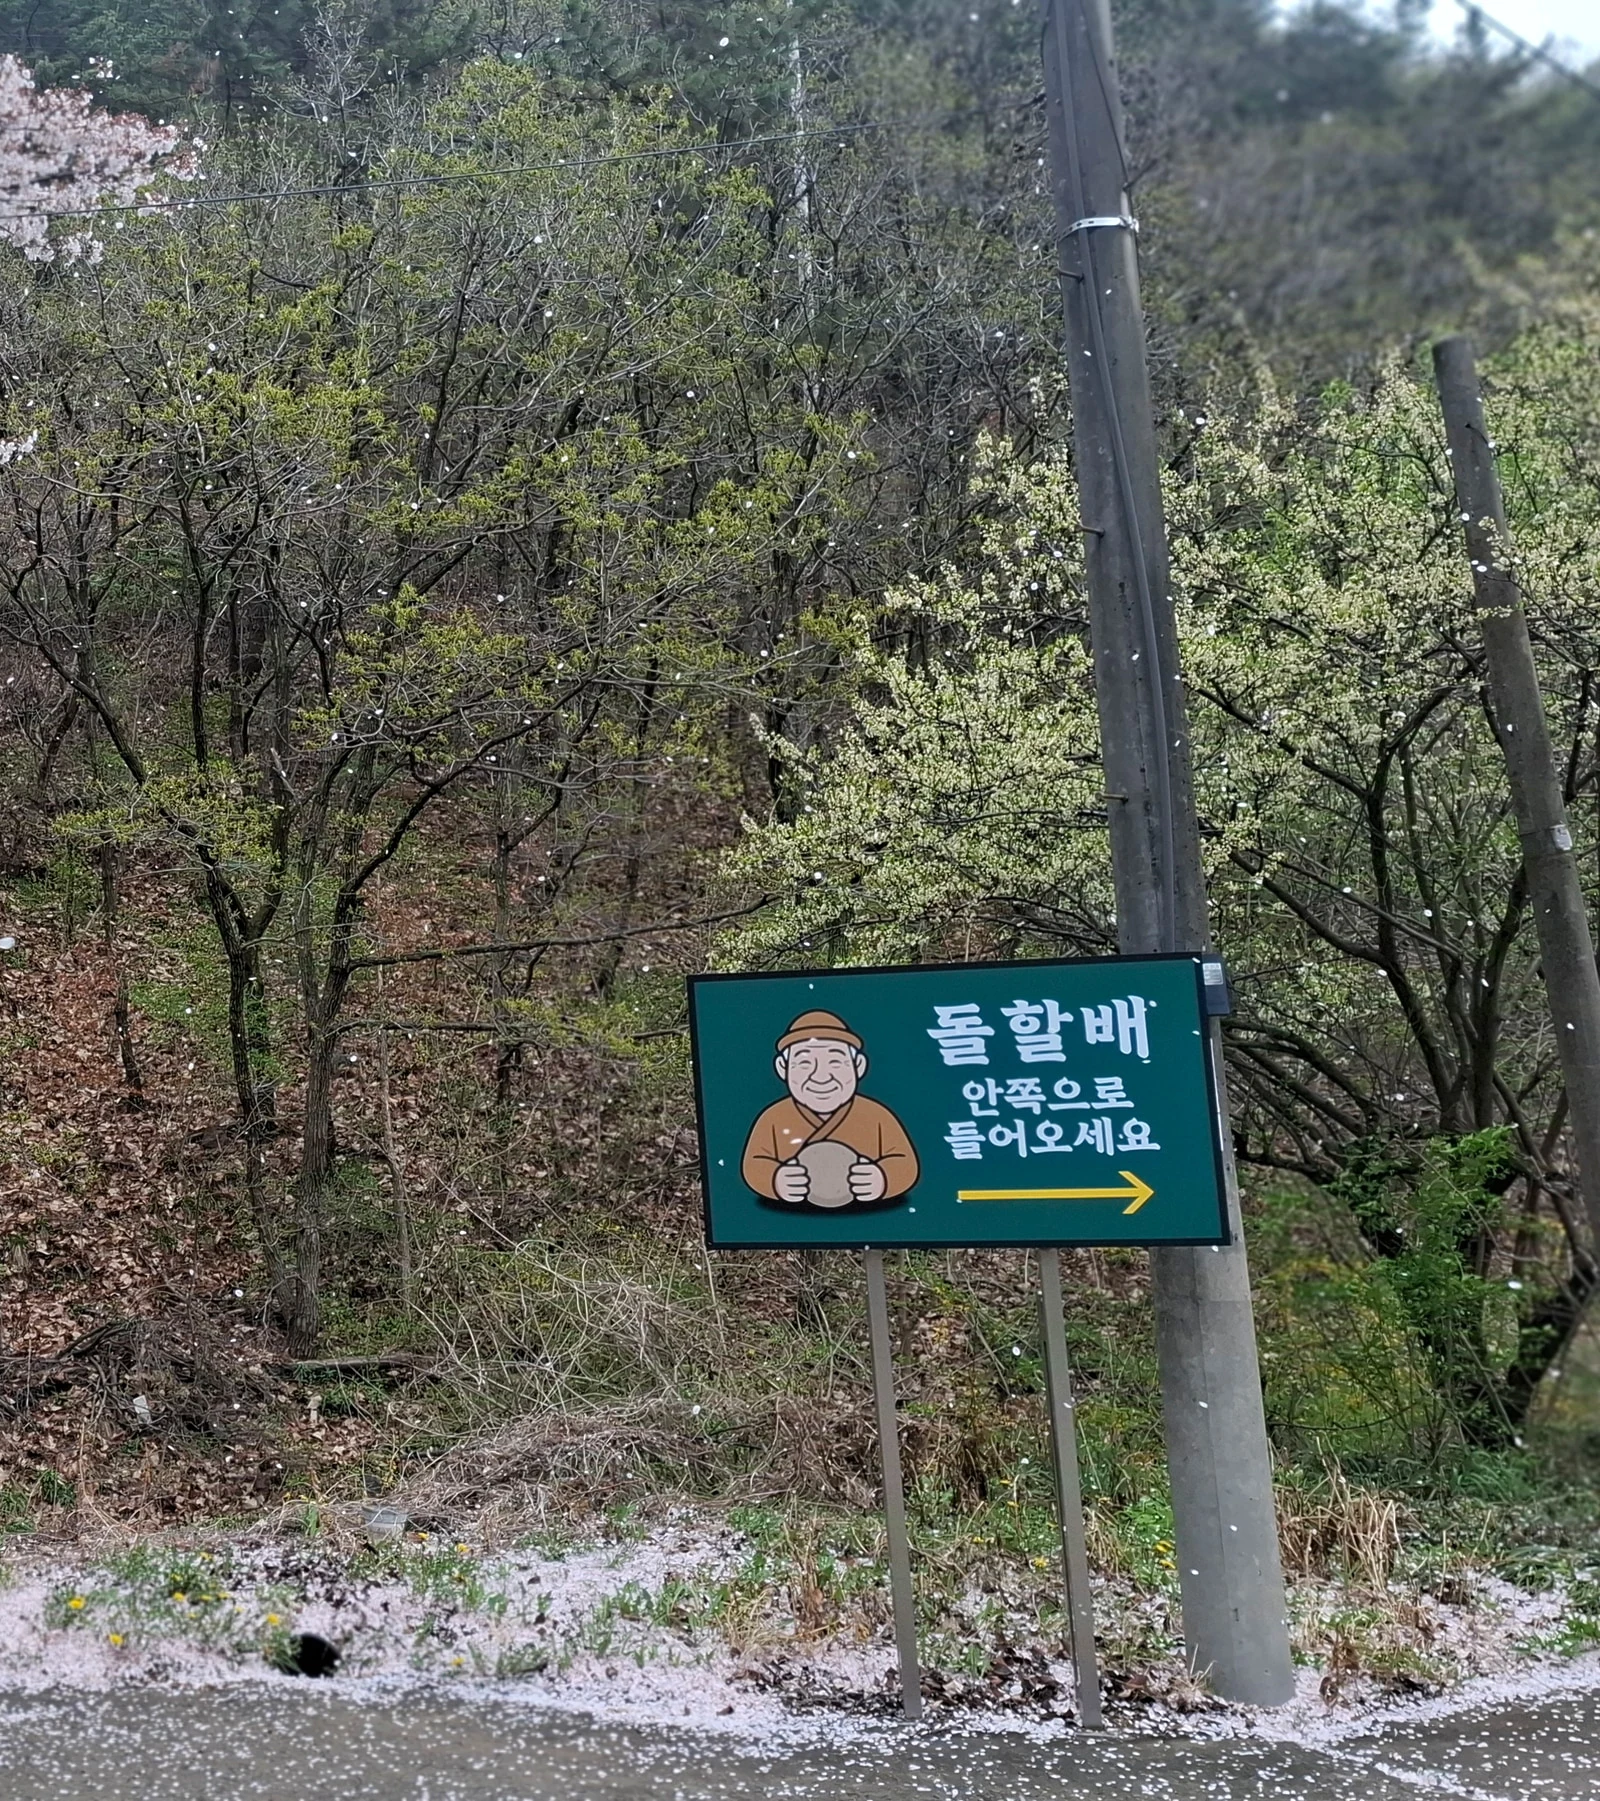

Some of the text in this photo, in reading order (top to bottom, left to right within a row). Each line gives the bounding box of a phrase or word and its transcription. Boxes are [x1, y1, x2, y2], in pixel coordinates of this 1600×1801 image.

[927, 995, 1150, 1066] 돌할배
[962, 1076, 1135, 1117] 안쪽으로
[943, 1117, 1161, 1160] 들어오세요
